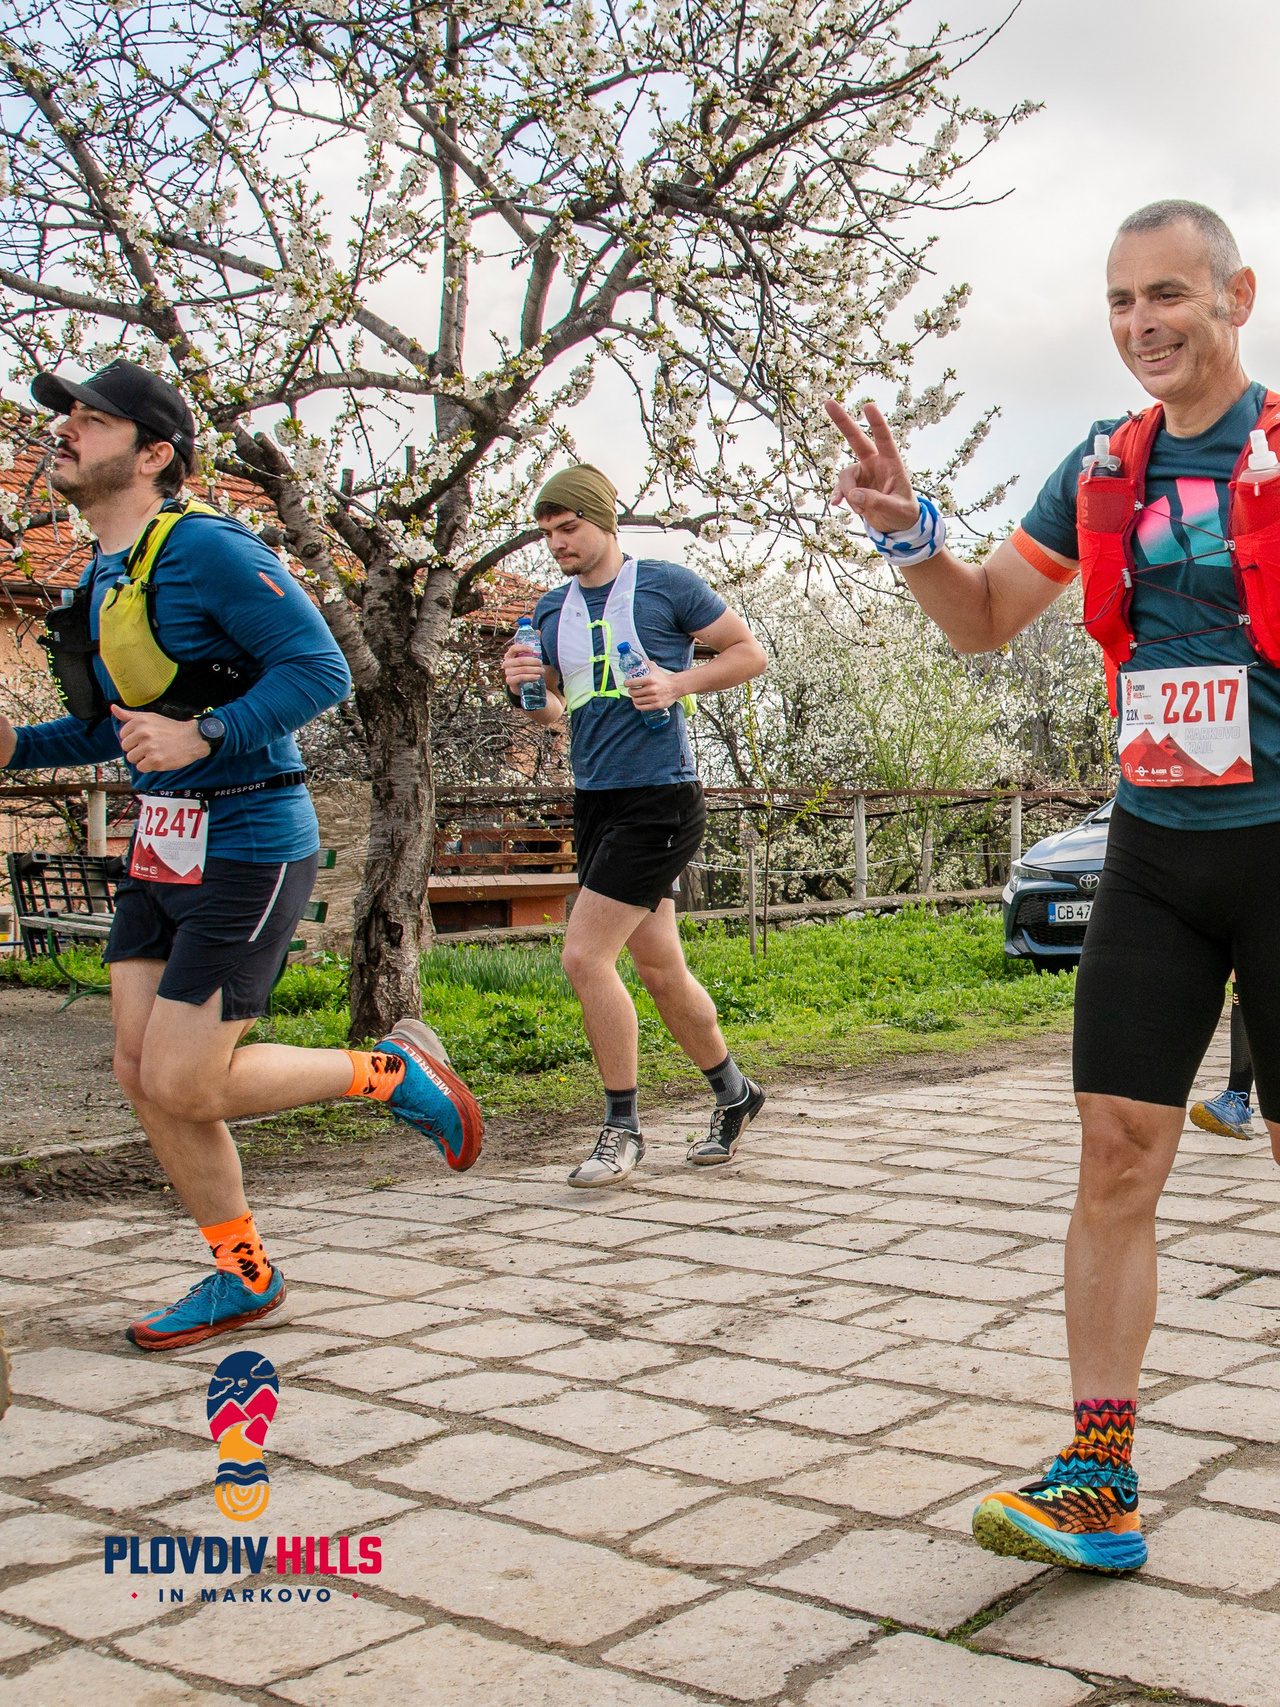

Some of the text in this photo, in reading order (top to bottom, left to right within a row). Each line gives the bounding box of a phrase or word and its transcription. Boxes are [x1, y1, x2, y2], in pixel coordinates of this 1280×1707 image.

[1161, 679, 1239, 725] 2217
[1126, 709, 1139, 721] 22K
[1184, 726, 1241, 741] MARKOVO
[1184, 741, 1214, 755] TRAIL
[145, 806, 203, 839] 2247
[402, 1042, 452, 1097] MERRELL
